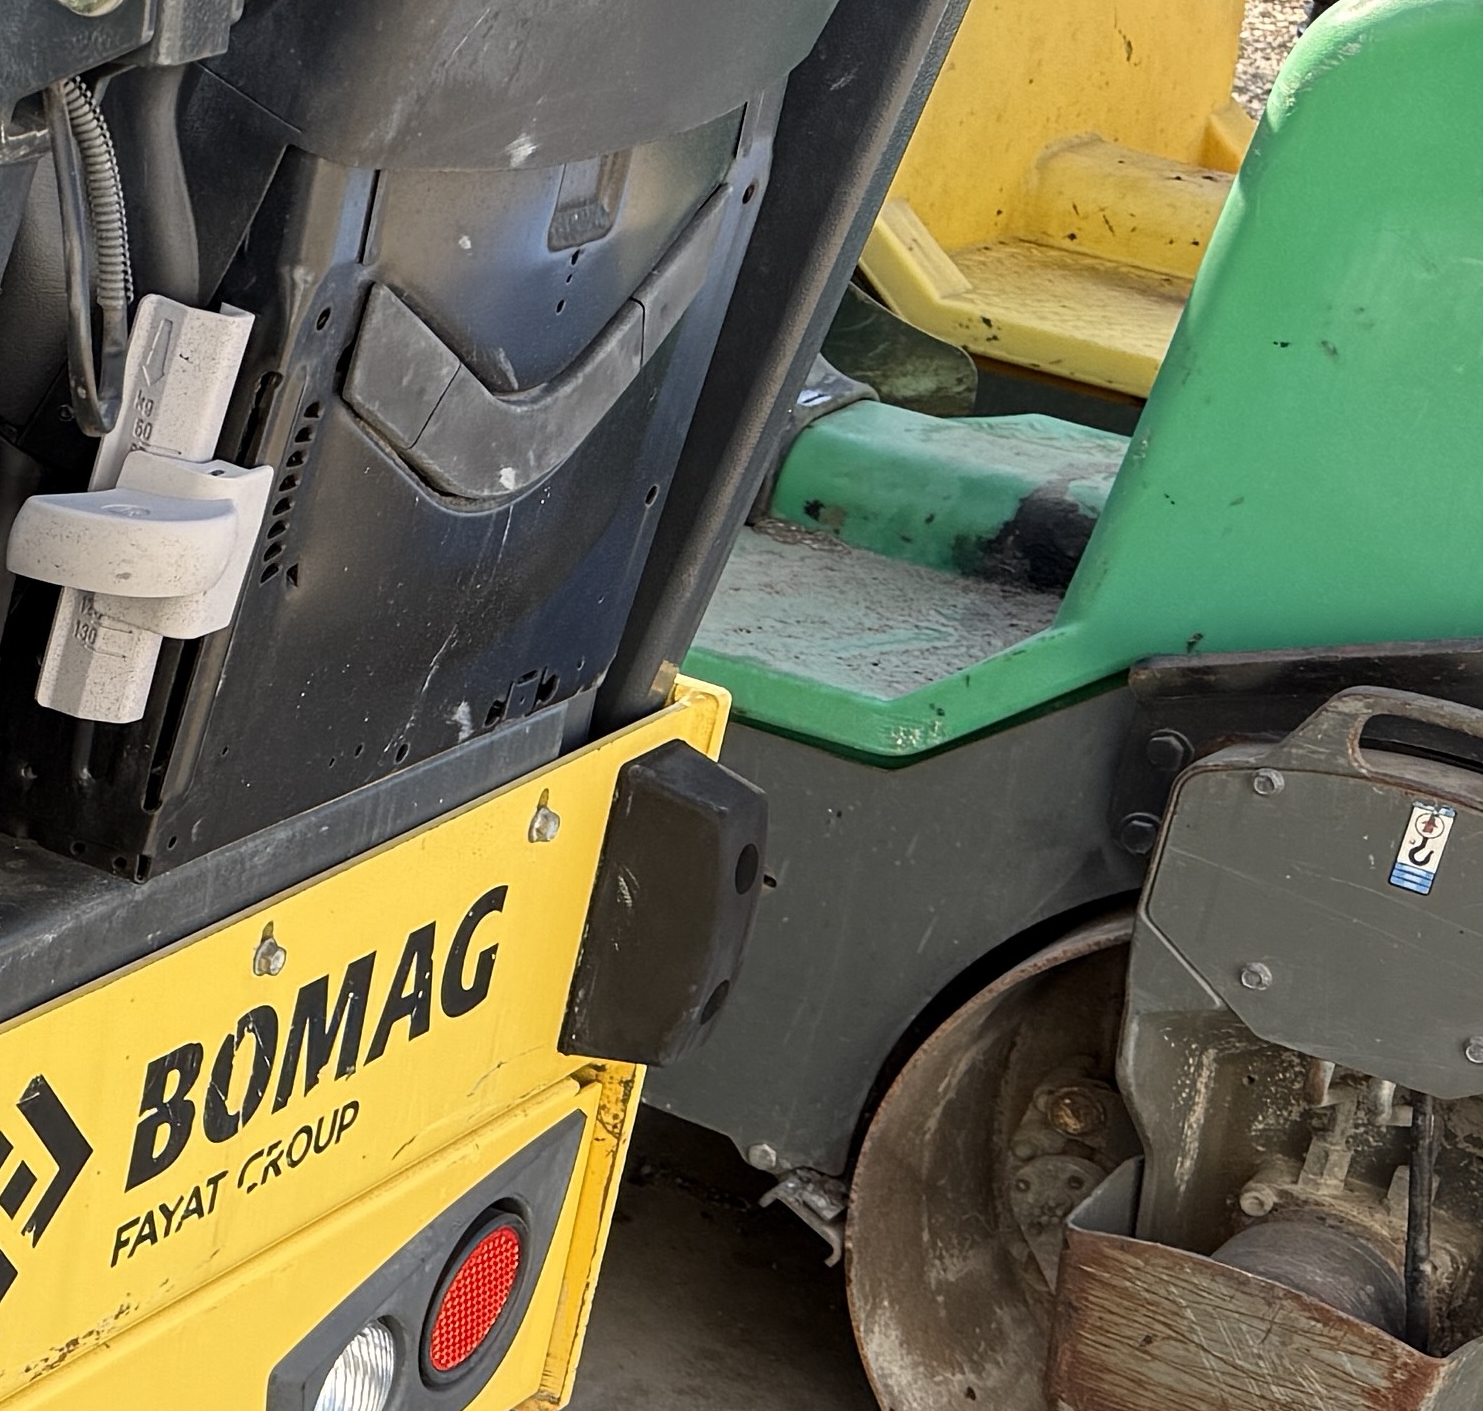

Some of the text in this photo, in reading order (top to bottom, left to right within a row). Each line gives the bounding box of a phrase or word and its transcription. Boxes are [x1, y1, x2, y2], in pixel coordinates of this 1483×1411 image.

[133, 389, 154, 418] kg
[124, 884, 509, 1194] BOMAG
[110, 1169, 228, 1268] FAYAT
